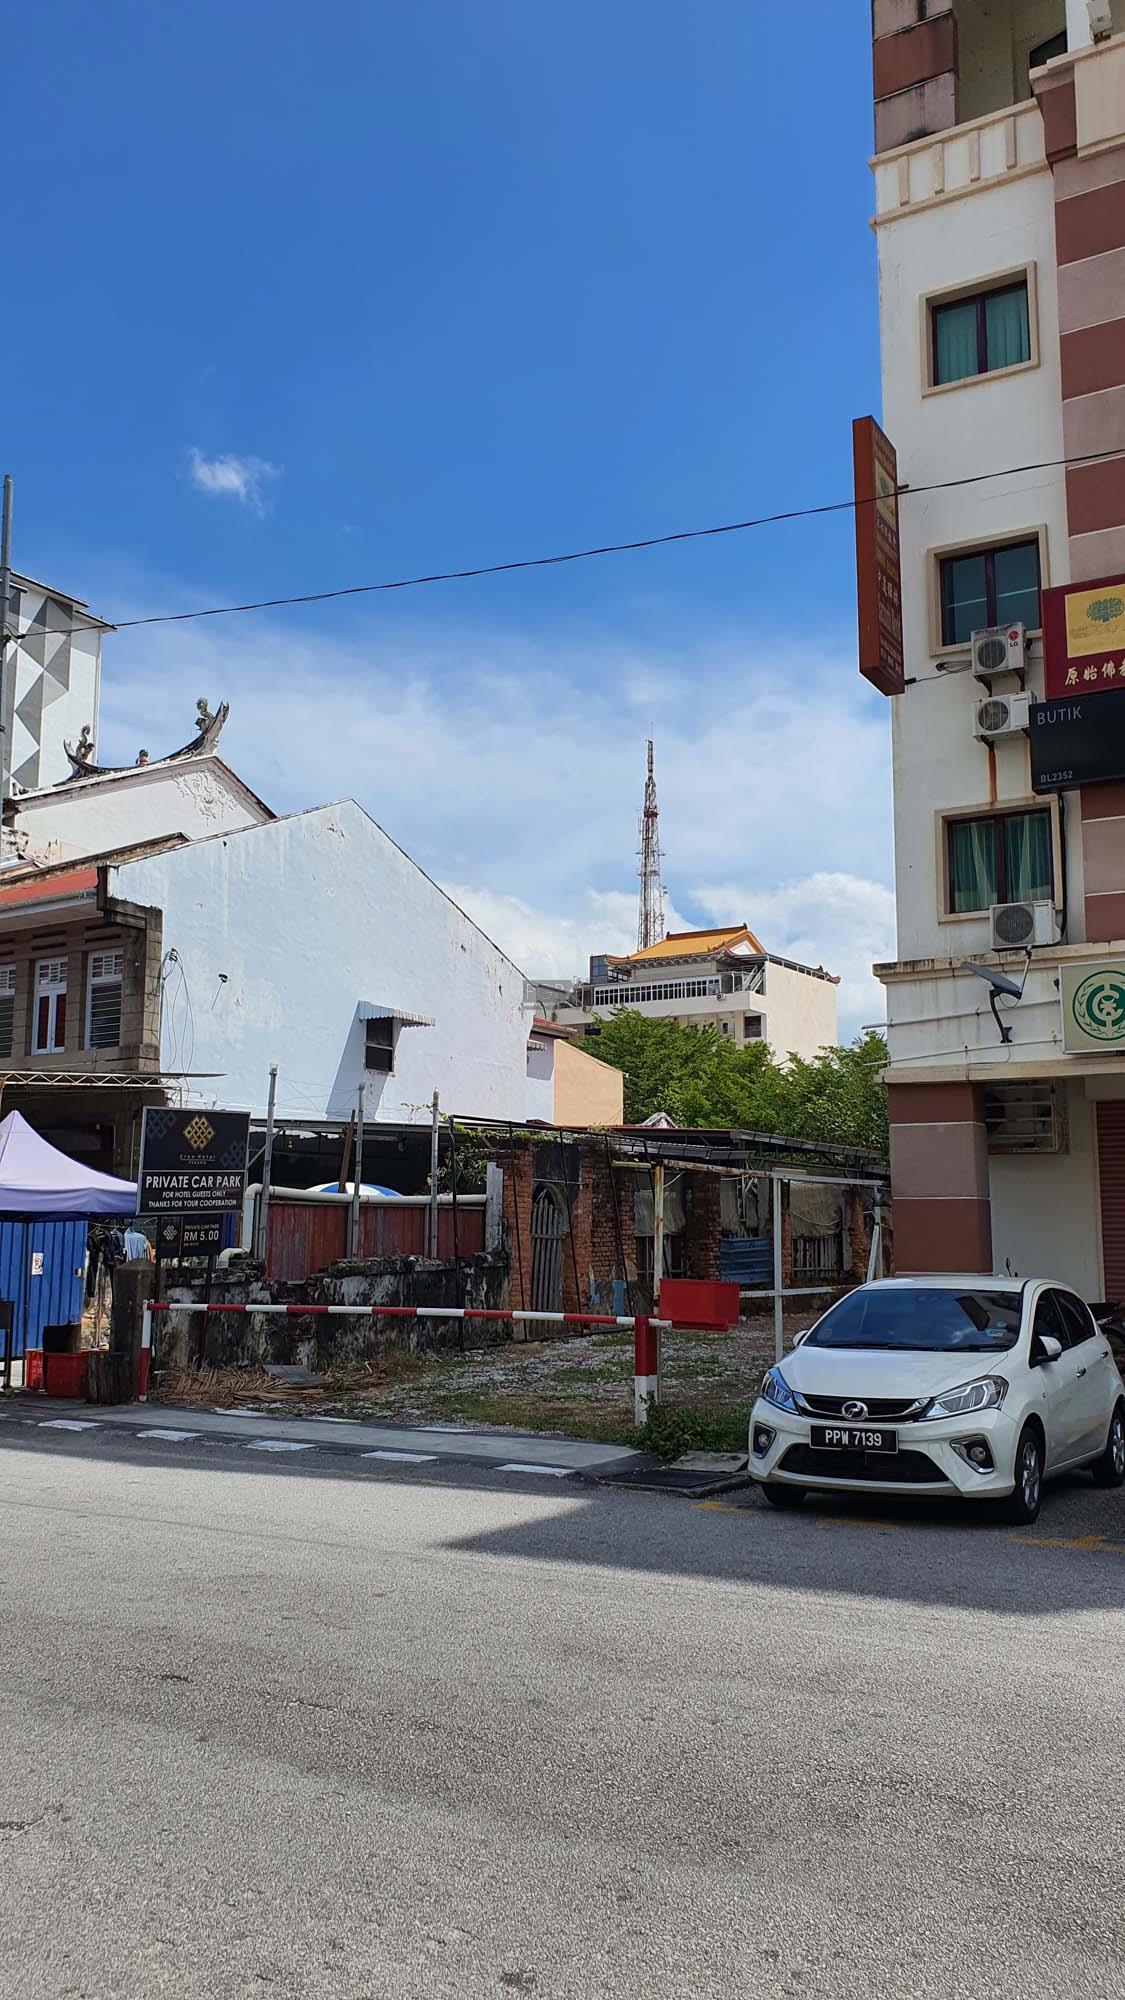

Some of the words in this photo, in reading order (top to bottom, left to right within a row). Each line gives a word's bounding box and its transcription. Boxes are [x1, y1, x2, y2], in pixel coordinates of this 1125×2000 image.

[1037, 706, 1082, 725] BUTIK
[1040, 770, 1073, 783] BL2352
[145, 1175, 189, 1189] PRIVATE
[191, 1175, 214, 1188] CAR
[216, 1175, 241, 1188] PARK
[192, 1190, 211, 1198] GUESTS
[199, 1199, 237, 1207] COOPERATION
[183, 1231, 198, 1241] RM
[199, 1230, 219, 1241] 5.00
[825, 1429, 849, 1445] PPW
[852, 1431, 882, 1446] 7139
